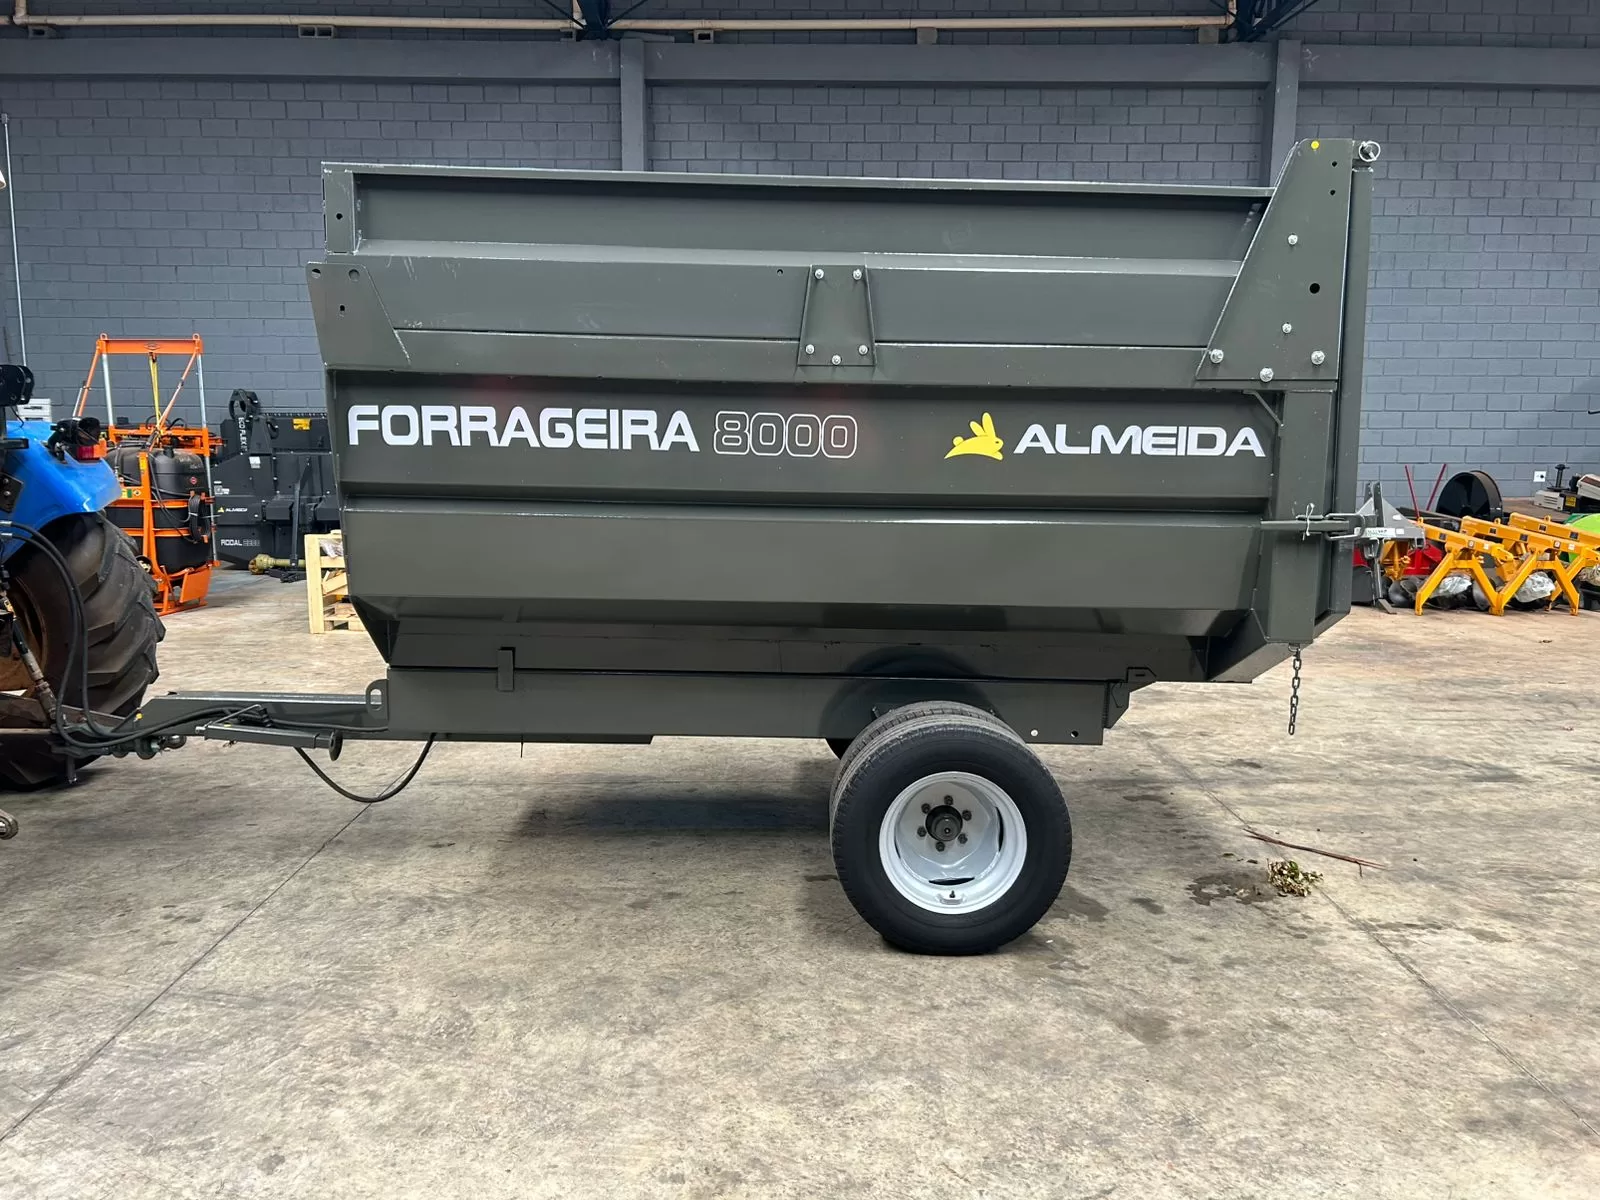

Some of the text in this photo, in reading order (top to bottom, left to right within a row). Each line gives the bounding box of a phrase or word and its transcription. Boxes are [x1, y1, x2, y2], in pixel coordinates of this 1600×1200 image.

[347, 405, 858, 459] FORRAGEIRA 8000
[1013, 423, 1266, 458] ALMEIDA
